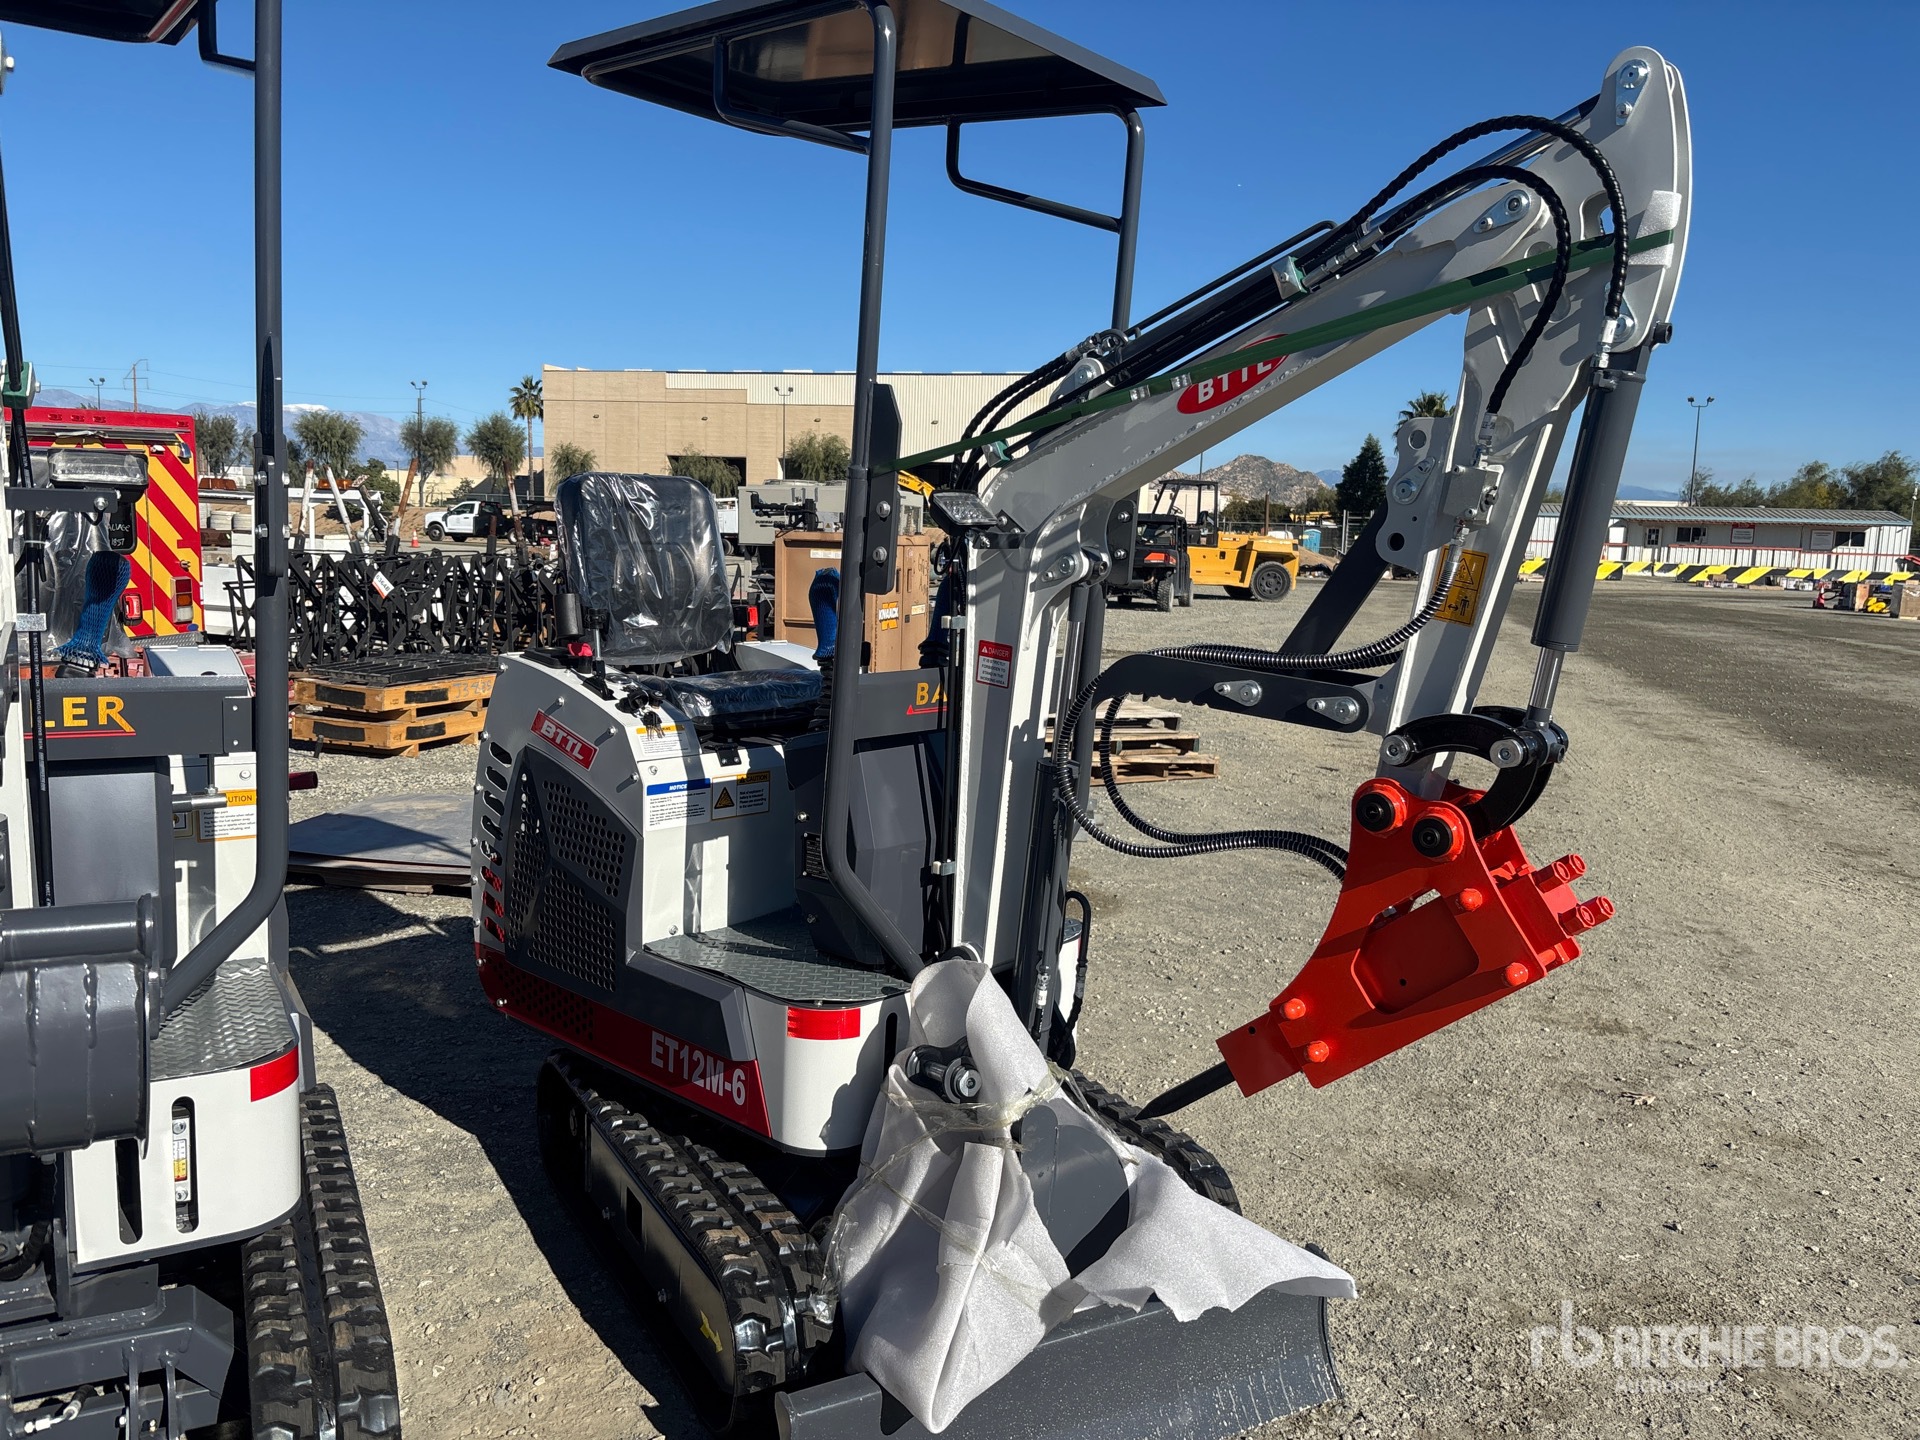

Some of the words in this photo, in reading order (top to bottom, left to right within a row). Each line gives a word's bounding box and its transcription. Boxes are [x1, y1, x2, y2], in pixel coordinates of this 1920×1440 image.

[988, 647, 1009, 657] DANGER
[541, 720, 584, 760] BTTL
[747, 774, 768, 783] CAUTION
[651, 1030, 746, 1106] ET12M-6
